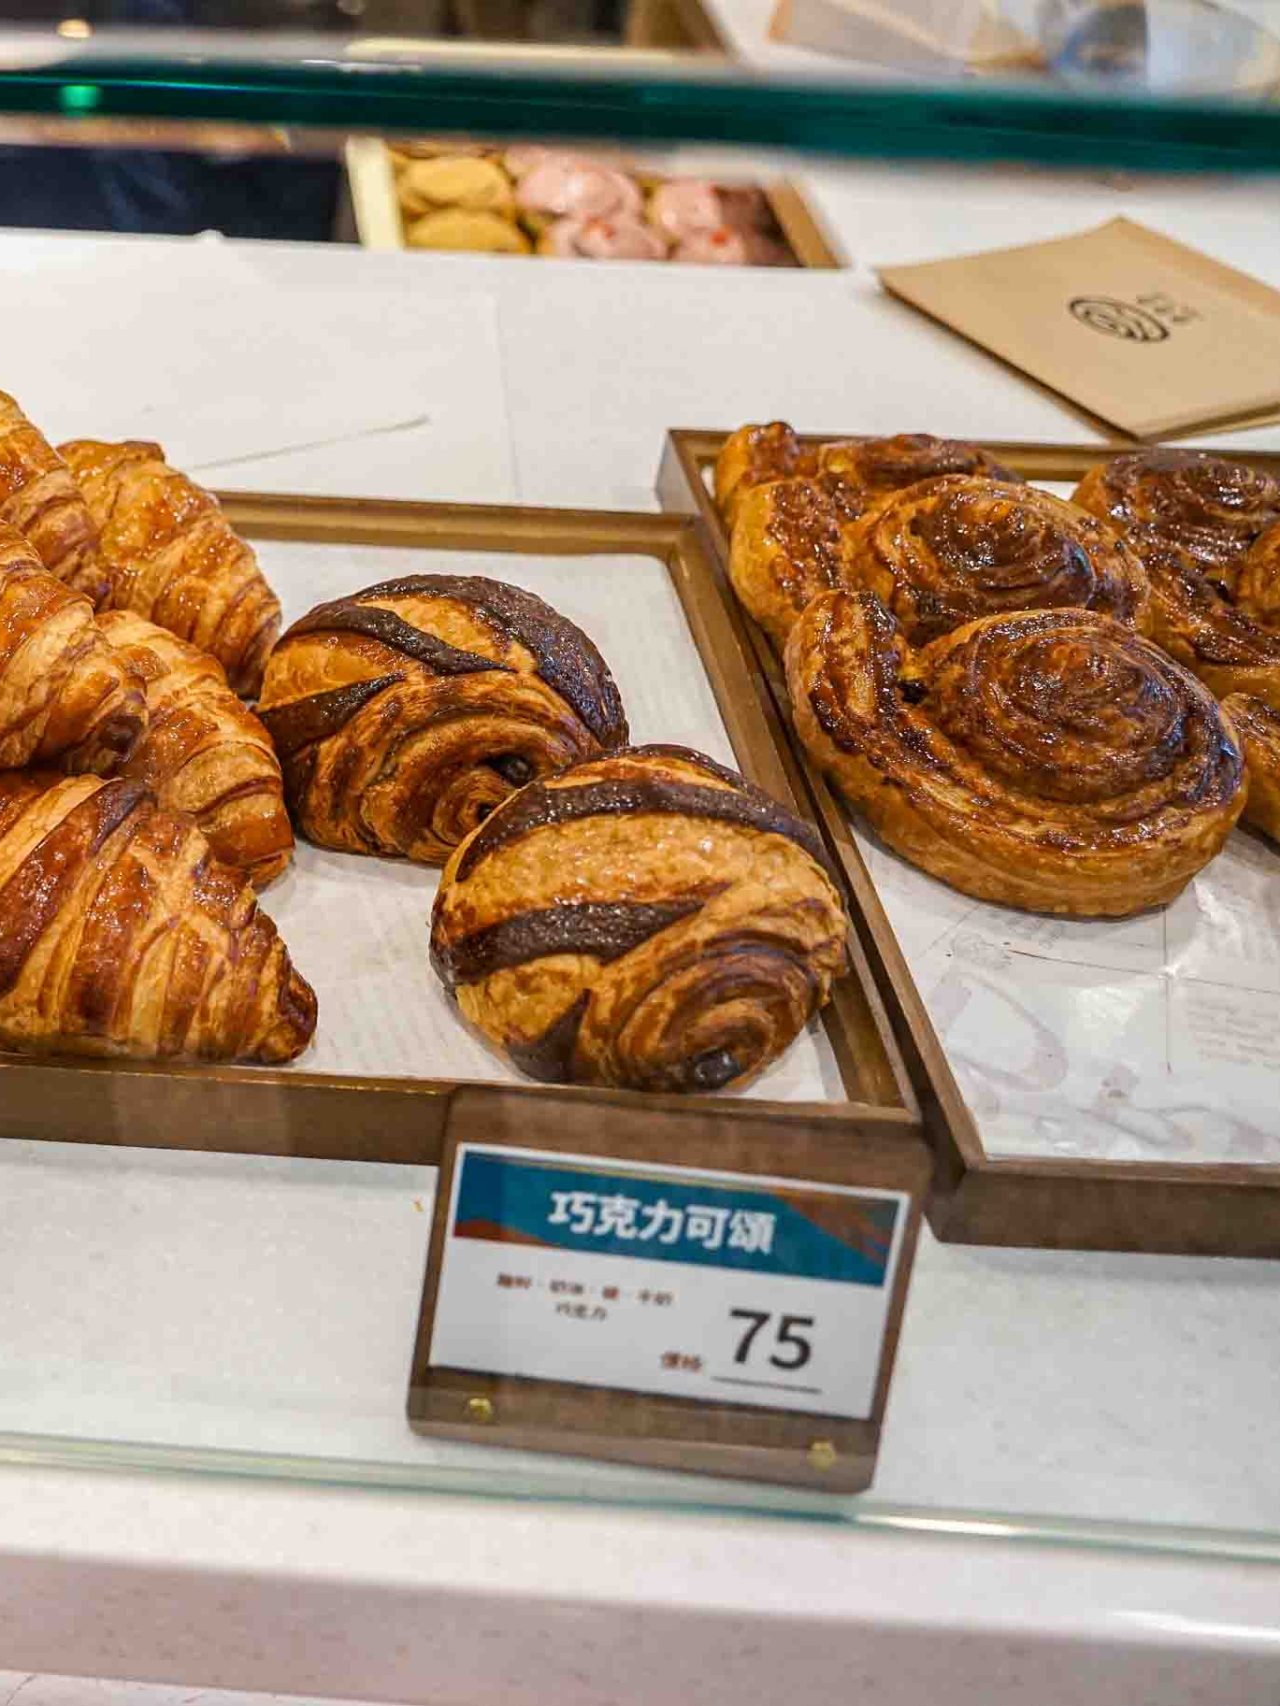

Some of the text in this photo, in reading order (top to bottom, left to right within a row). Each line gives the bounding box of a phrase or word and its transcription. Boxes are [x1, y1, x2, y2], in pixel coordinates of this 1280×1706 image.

[547, 1190, 777, 1254] 巧克力可頌
[728, 1308, 816, 1371] 75
